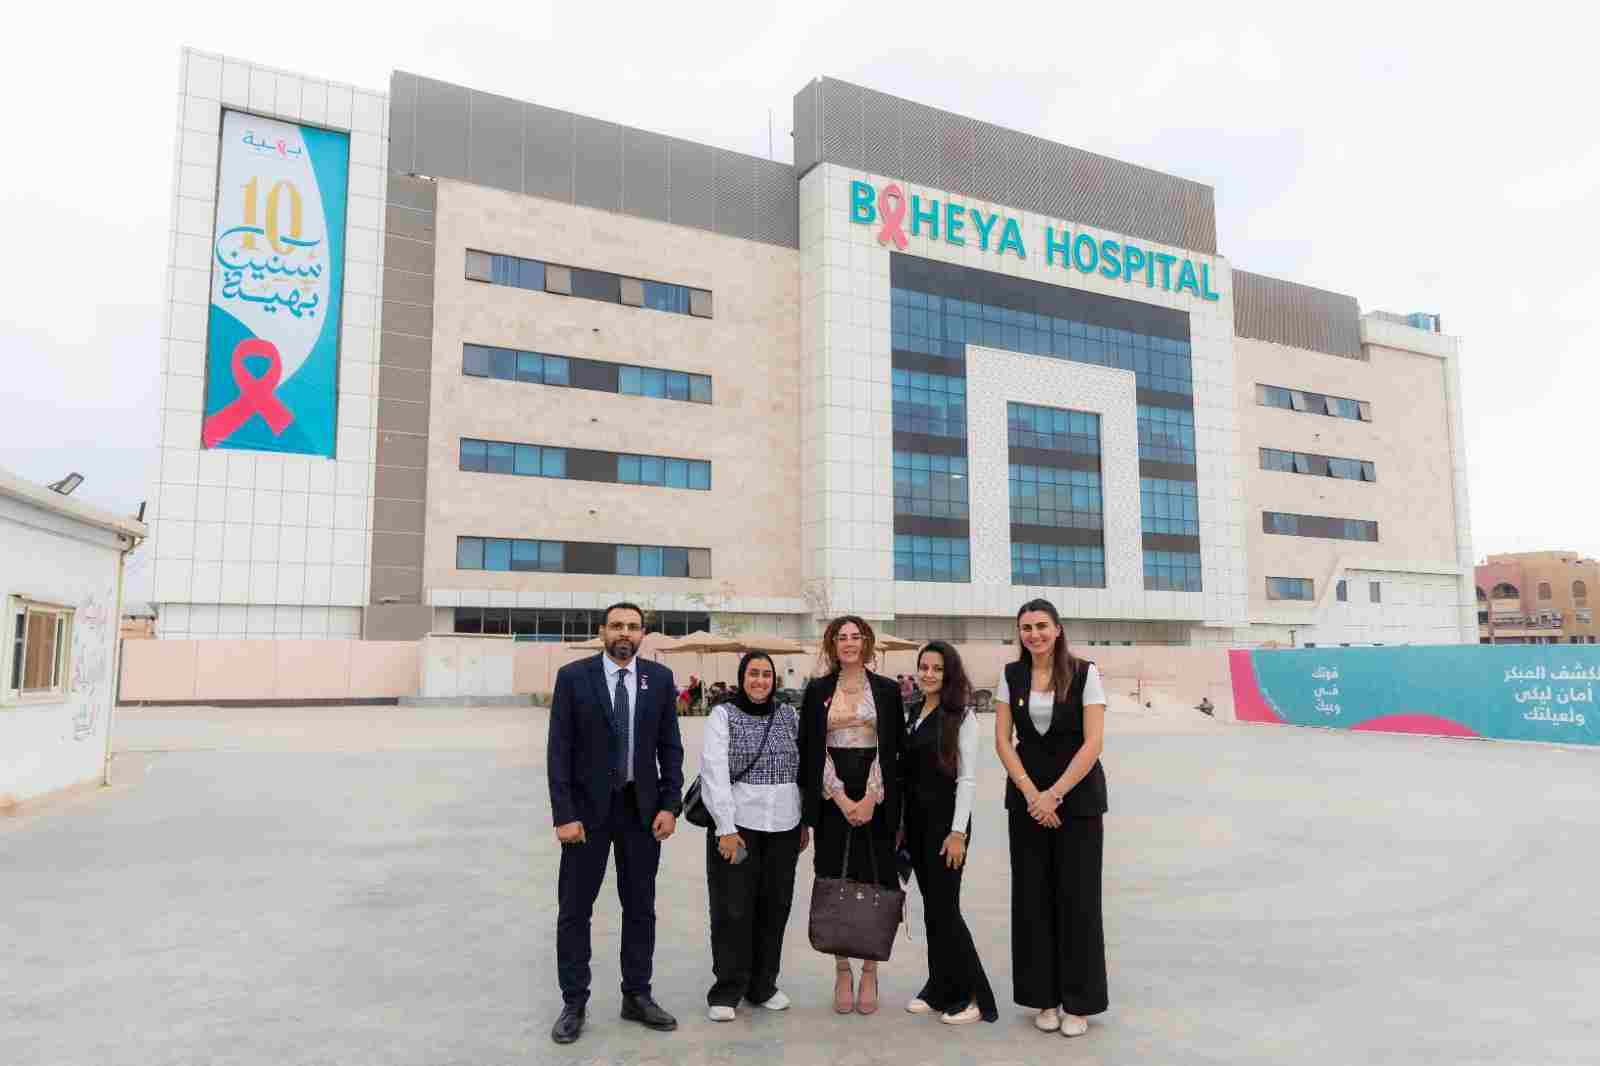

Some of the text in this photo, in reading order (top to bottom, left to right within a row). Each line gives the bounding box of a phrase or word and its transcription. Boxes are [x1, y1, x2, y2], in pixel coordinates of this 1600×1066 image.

[240, 175, 302, 255] 10
[216, 227, 321, 279] سنين
[1046, 222, 1220, 301] HOSPITAL
[223, 271, 319, 318] بهية
[1503, 664, 1546, 684] المبكر
[1557, 681, 1592, 705] أمان
